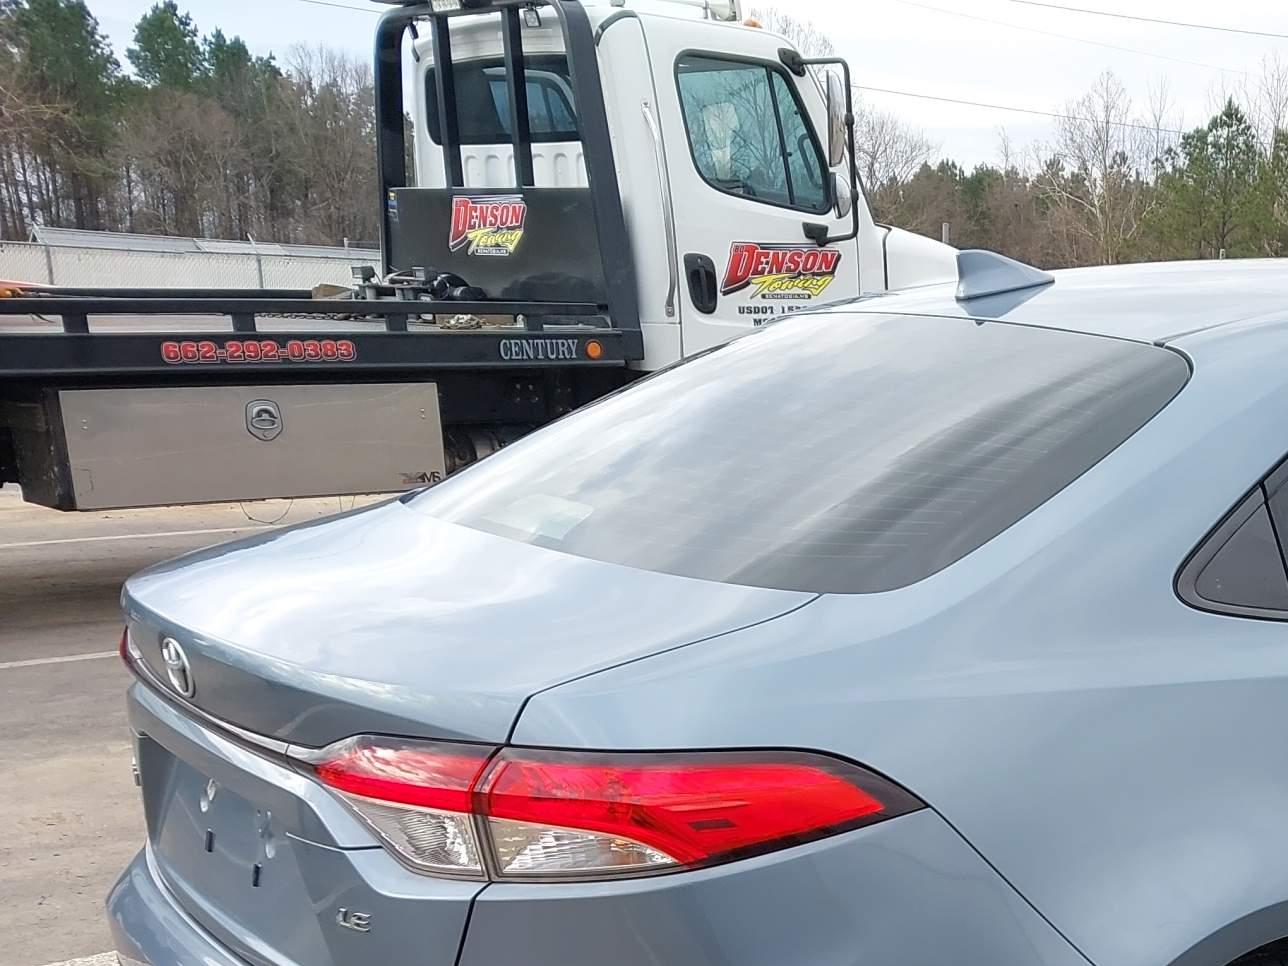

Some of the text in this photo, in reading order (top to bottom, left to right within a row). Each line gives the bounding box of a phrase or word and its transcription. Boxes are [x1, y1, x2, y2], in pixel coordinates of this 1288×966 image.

[450, 196, 525, 250] DENSON
[467, 227, 524, 255] Towing
[720, 241, 840, 293] DENSON
[750, 273, 834, 299] Towing
[161, 340, 356, 363] 662-292-0383
[500, 339, 578, 360] CENTURY
[337, 907, 371, 932] LE
